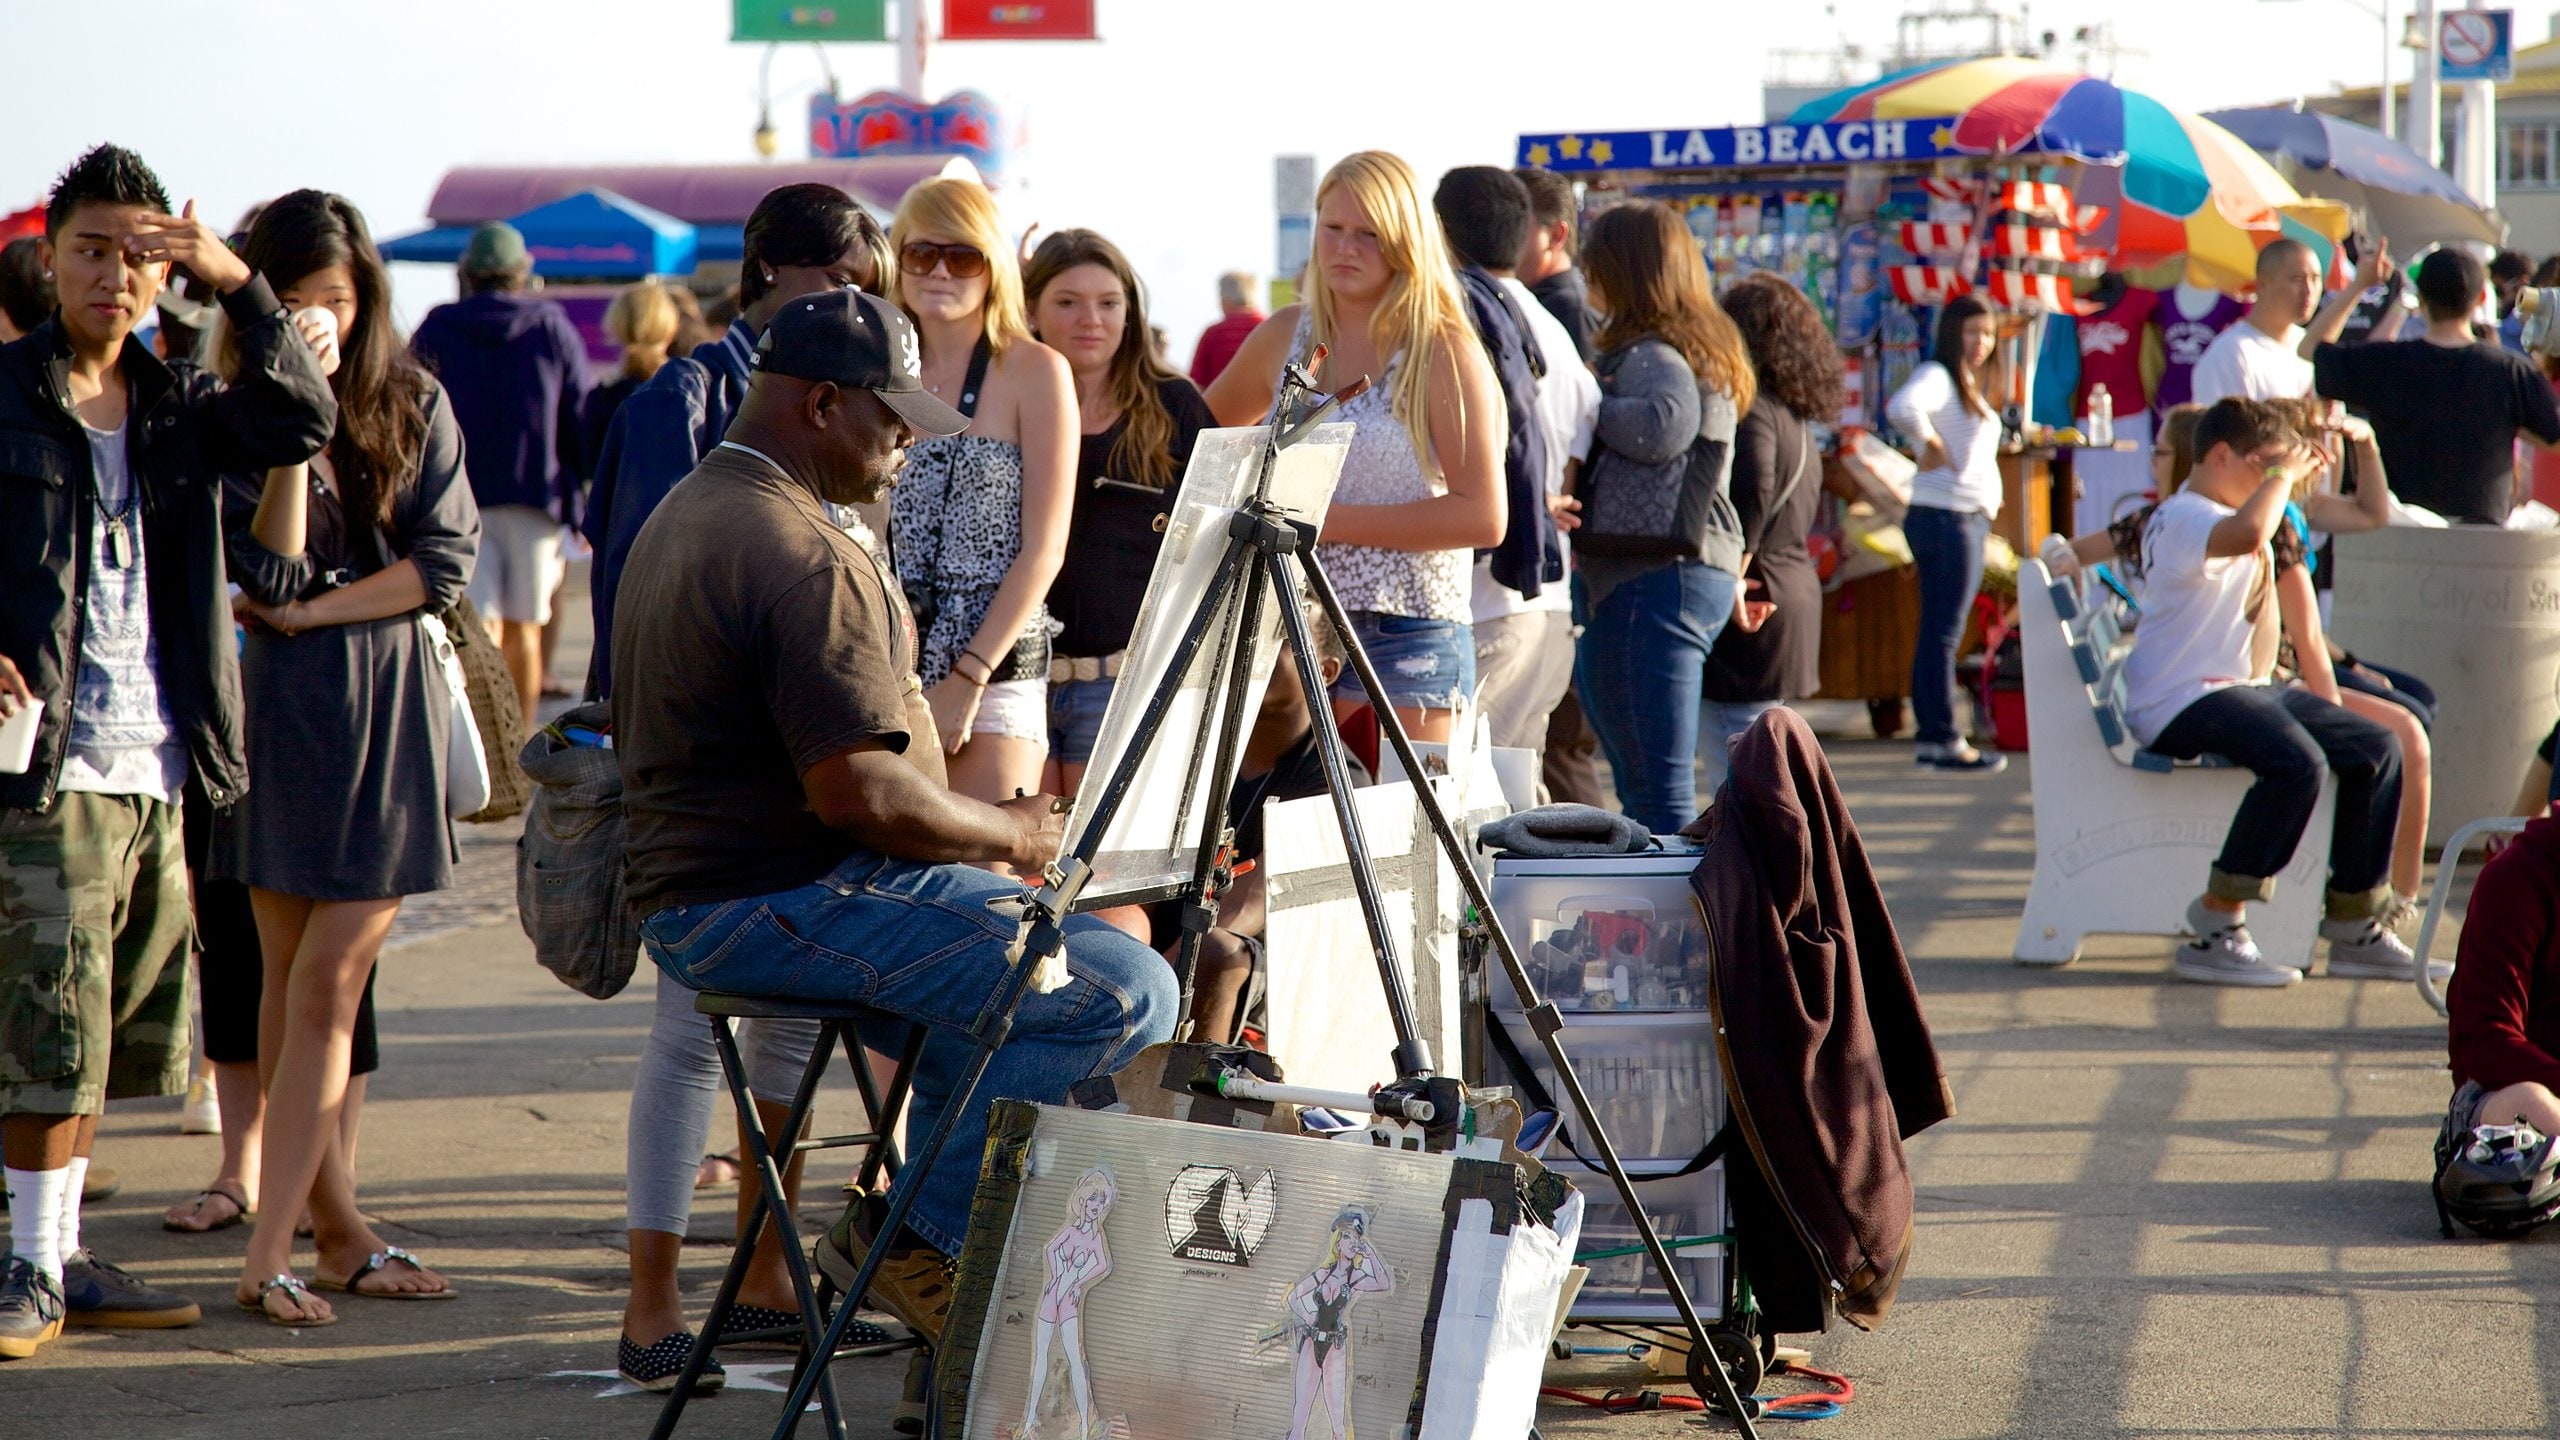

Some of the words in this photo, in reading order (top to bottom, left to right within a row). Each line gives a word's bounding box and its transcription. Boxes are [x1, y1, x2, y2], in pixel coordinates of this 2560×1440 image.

[1649, 130, 1715, 167] LA
[1733, 121, 1907, 165] BEACH
[2419, 573, 2474, 620] City
[2482, 575, 2512, 612] of
[1187, 1246, 1237, 1263] DESIGNS
